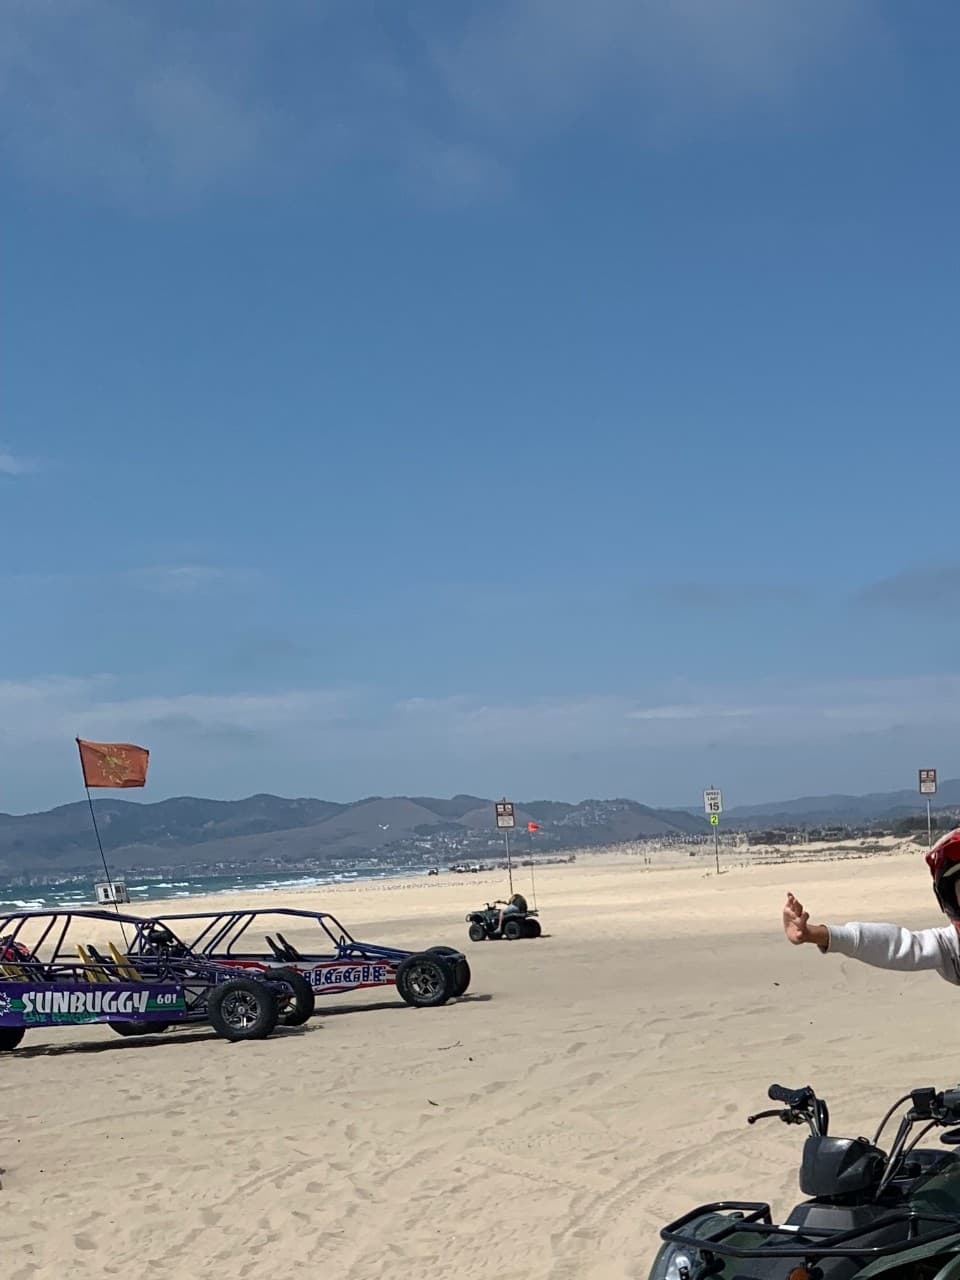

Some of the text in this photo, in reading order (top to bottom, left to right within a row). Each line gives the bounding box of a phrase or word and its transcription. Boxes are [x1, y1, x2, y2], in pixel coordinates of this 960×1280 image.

[709, 802, 719, 811] 15
[711, 815, 717, 824] 2
[22, 990, 177, 1014] SUNBUGGY 601
